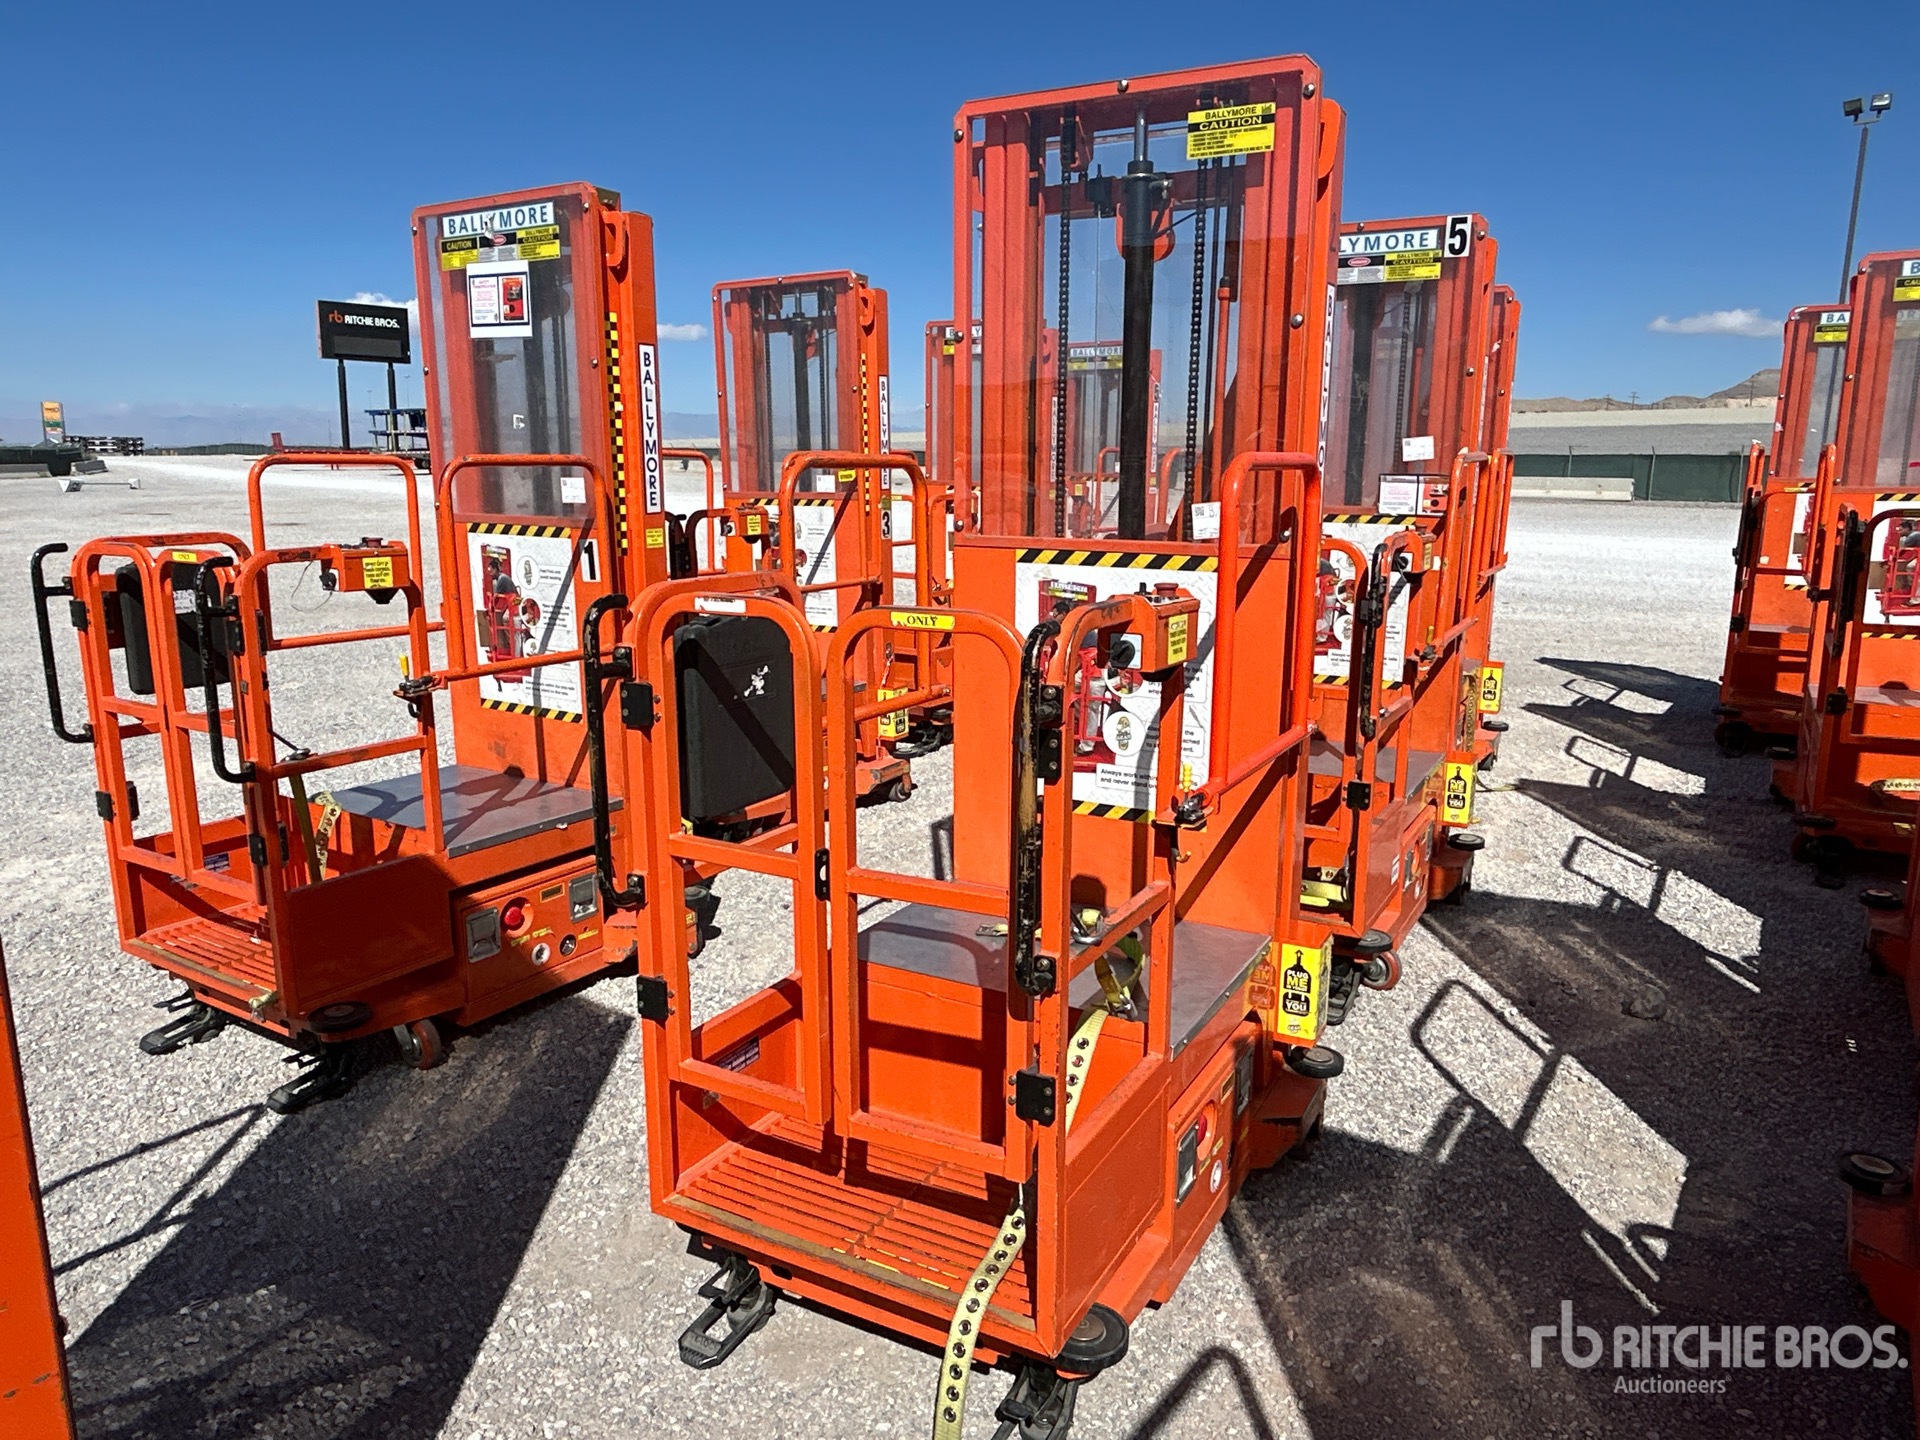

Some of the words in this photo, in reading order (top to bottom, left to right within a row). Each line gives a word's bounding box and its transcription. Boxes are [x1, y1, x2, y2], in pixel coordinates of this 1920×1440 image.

[1205, 106, 1257, 120] BALLYMORE
[1199, 116, 1262, 131] CAUTION
[1447, 216, 1468, 256] 5
[446, 241, 472, 251] CAUTION
[344, 314, 374, 326] RITCHIE
[374, 317, 400, 329] BROS.
[643, 352, 658, 507] BALLYMORE
[880, 380, 888, 486] BALLYME
[882, 511, 891, 537] 3
[583, 541, 597, 580] 1
[906, 615, 938, 627] ONLY
[1101, 768, 1122, 777] Always
[1286, 969, 1309, 979] PLUG
[1286, 975, 1308, 989] ME
[1286, 1000, 1307, 1011] YOU
